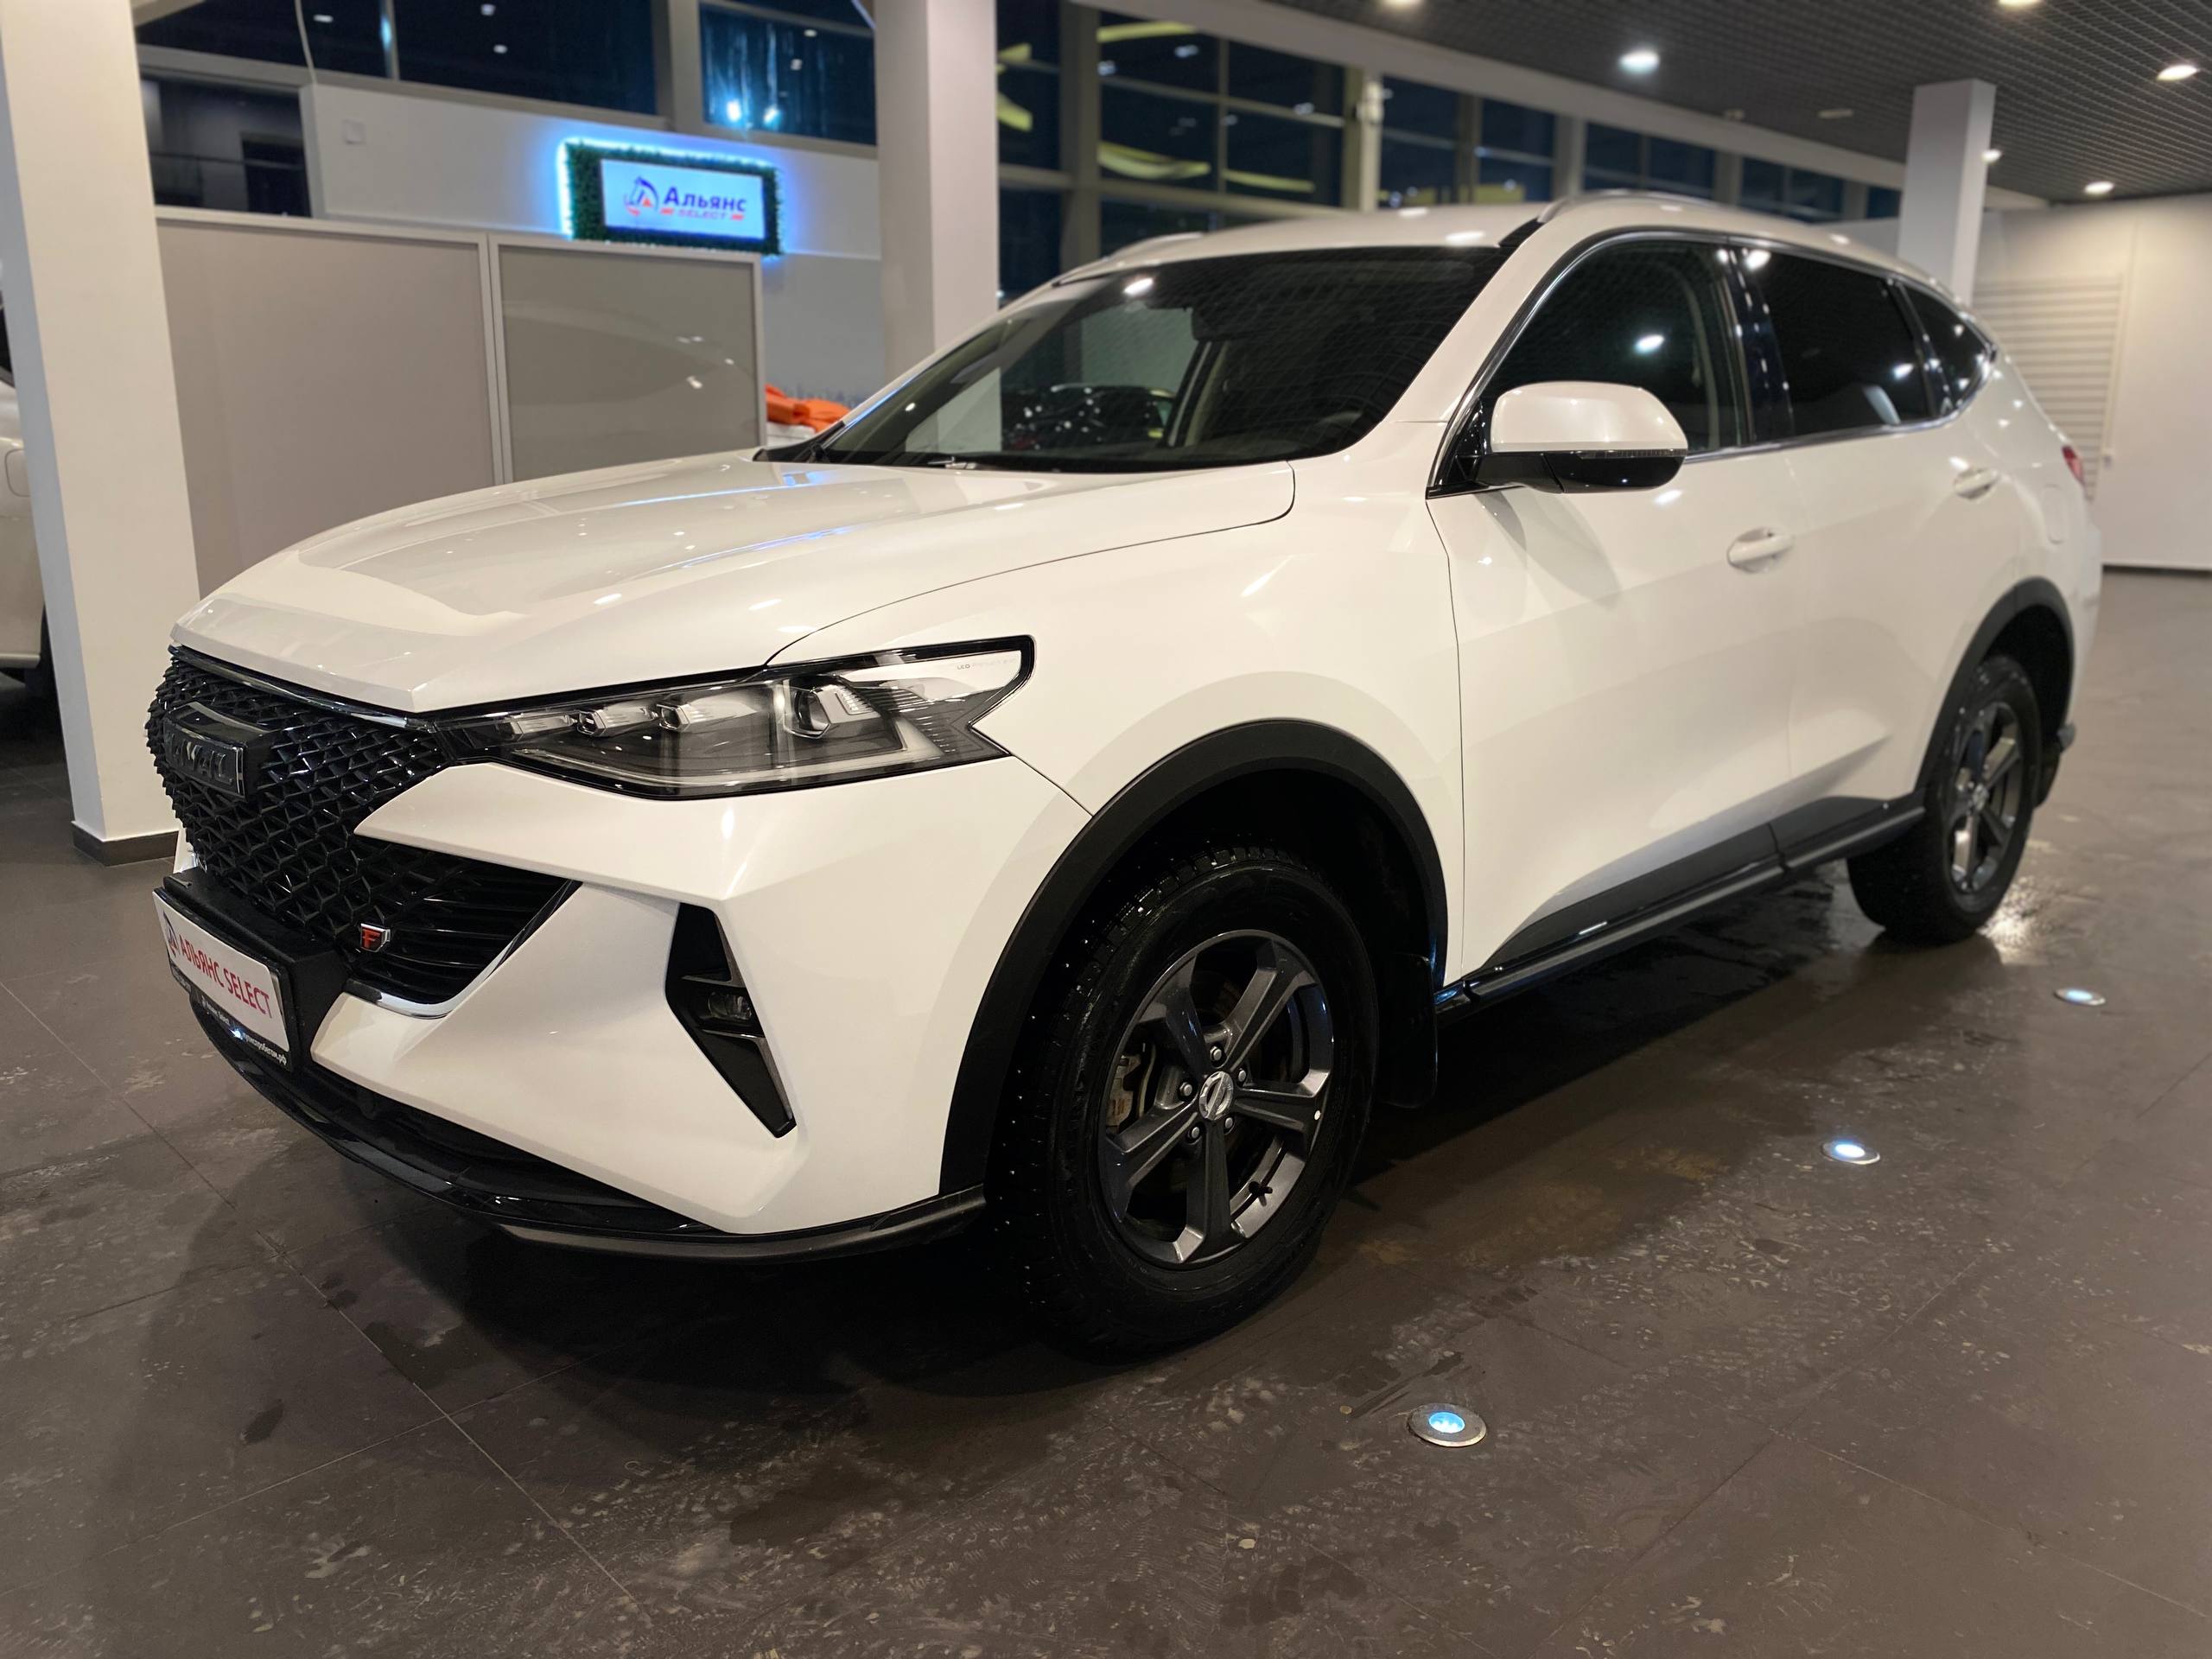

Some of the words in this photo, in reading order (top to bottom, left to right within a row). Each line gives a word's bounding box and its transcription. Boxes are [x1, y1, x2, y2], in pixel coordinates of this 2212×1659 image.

[663, 186, 747, 212] Альянс
[678, 209, 728, 220] SELECT
[361, 925, 383, 950] F
[179, 934, 225, 988] АЛЬЯНС
[223, 968, 272, 1019] SELECT
